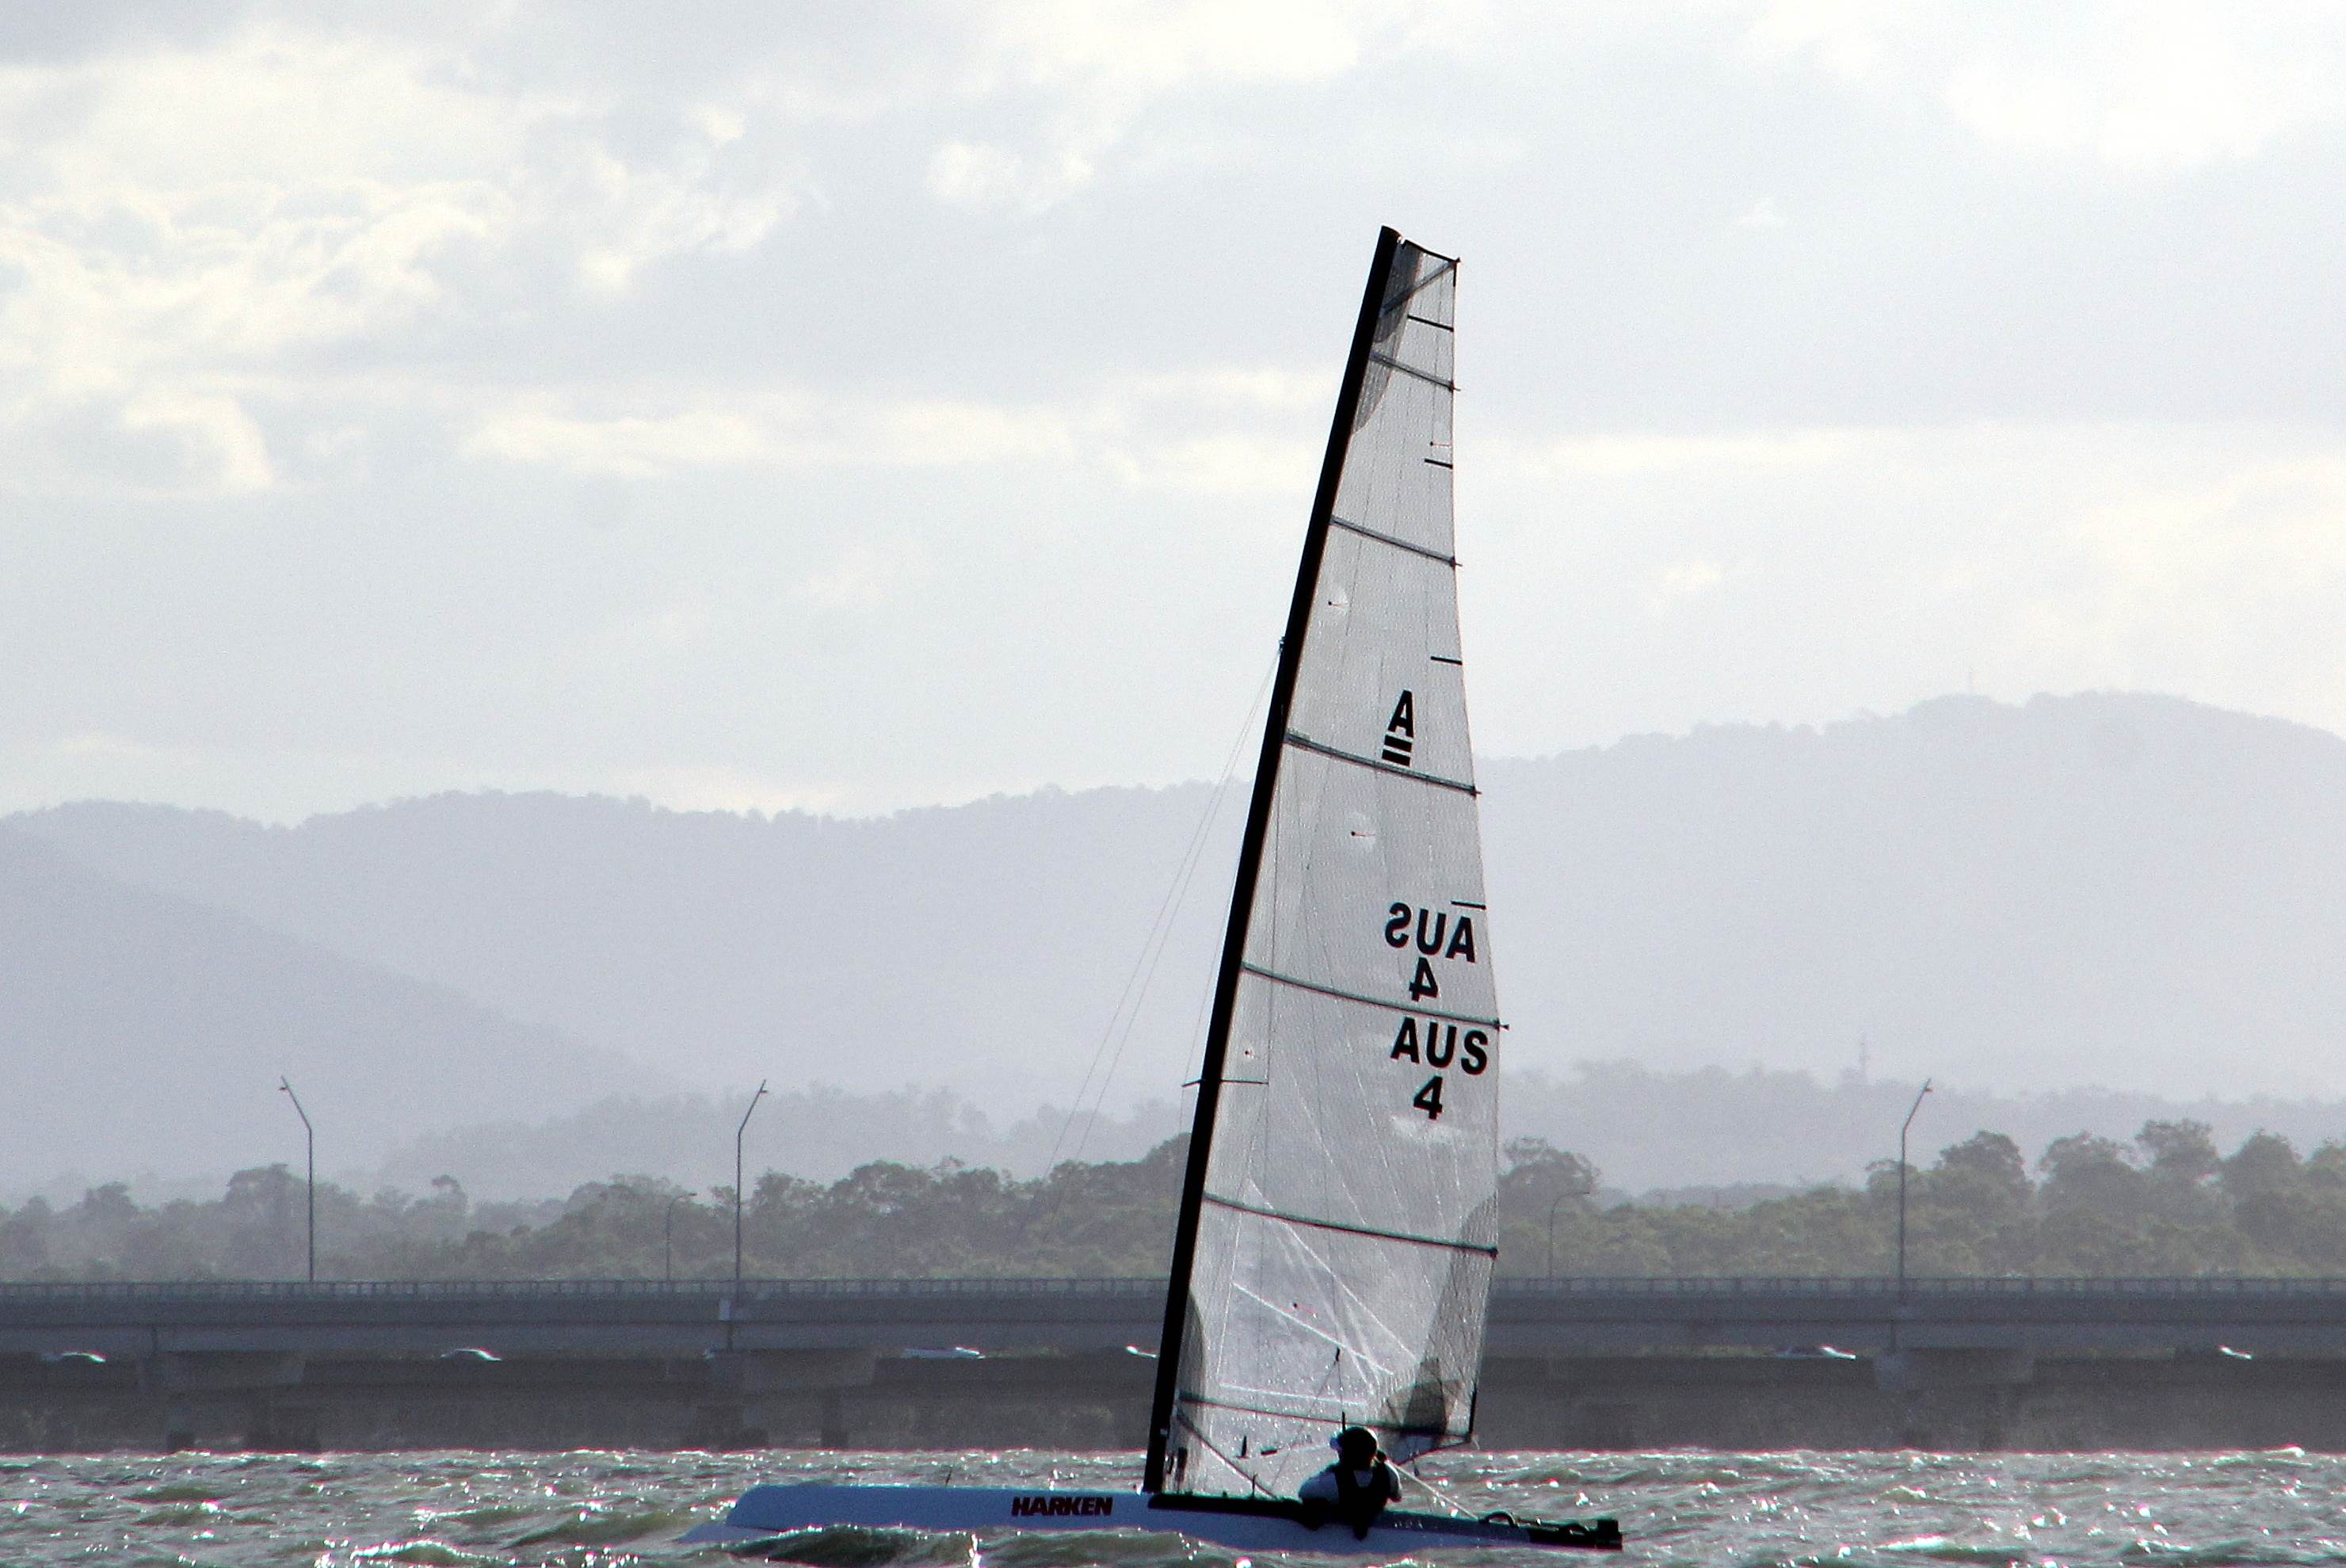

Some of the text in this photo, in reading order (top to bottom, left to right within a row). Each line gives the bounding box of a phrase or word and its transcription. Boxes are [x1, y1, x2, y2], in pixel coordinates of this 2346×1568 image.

[1390, 1017, 1488, 1075] AUS
[1413, 1075, 1444, 1120] 4
[1012, 1496, 1113, 1516] HARKEN
